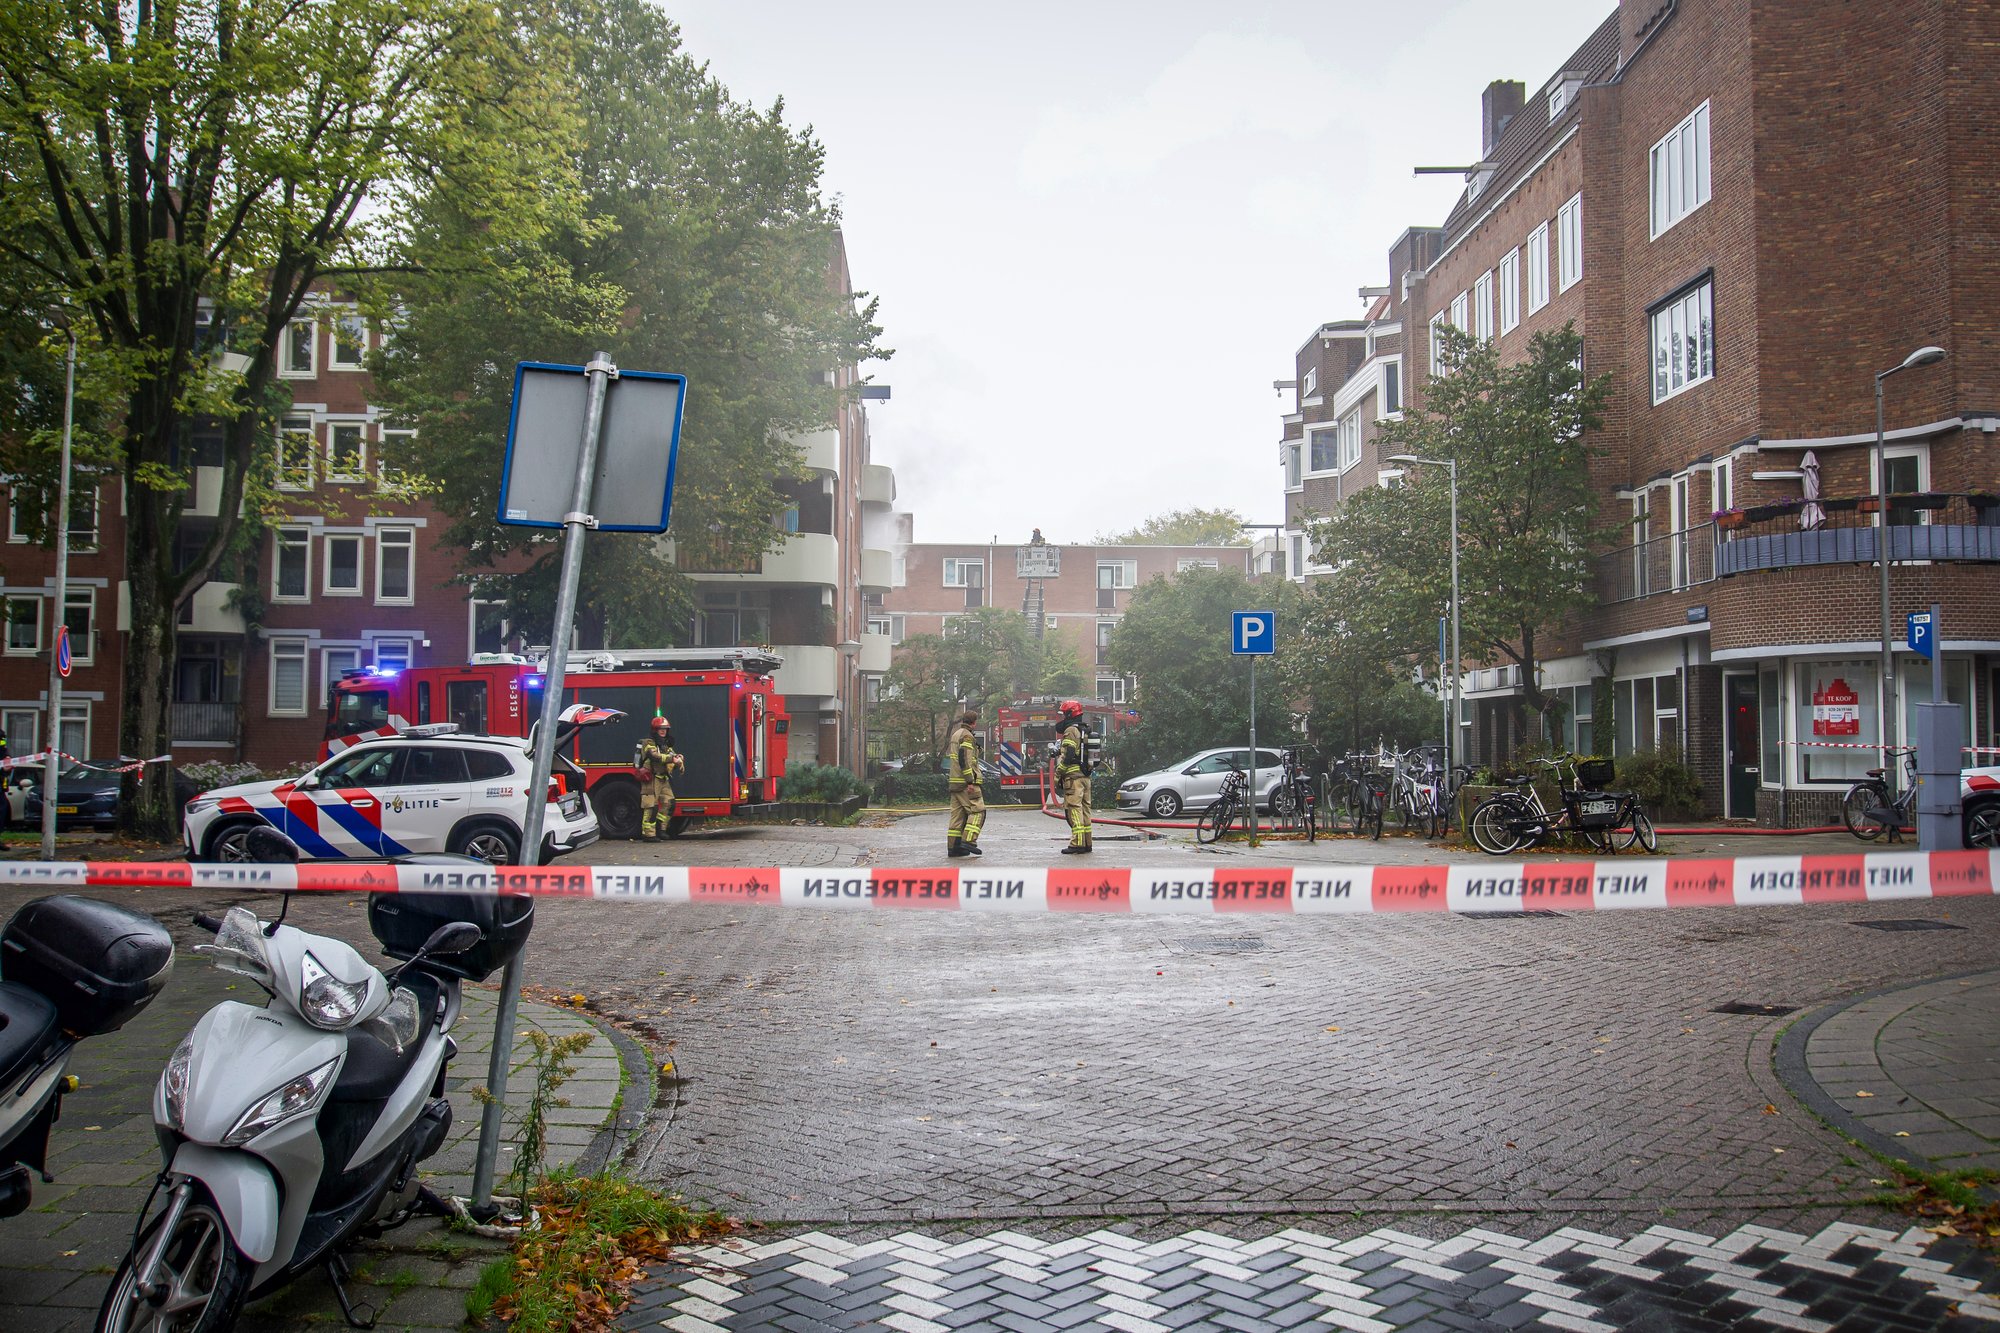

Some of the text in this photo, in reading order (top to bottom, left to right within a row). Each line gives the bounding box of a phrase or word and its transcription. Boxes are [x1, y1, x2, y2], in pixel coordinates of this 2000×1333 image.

[1242, 617, 1265, 649] P
[1915, 626, 1925, 643] P
[509, 678, 518, 717] 13-3131
[385, 799, 439, 813] POLITIE
[255, 1015, 283, 1026] HONDA
